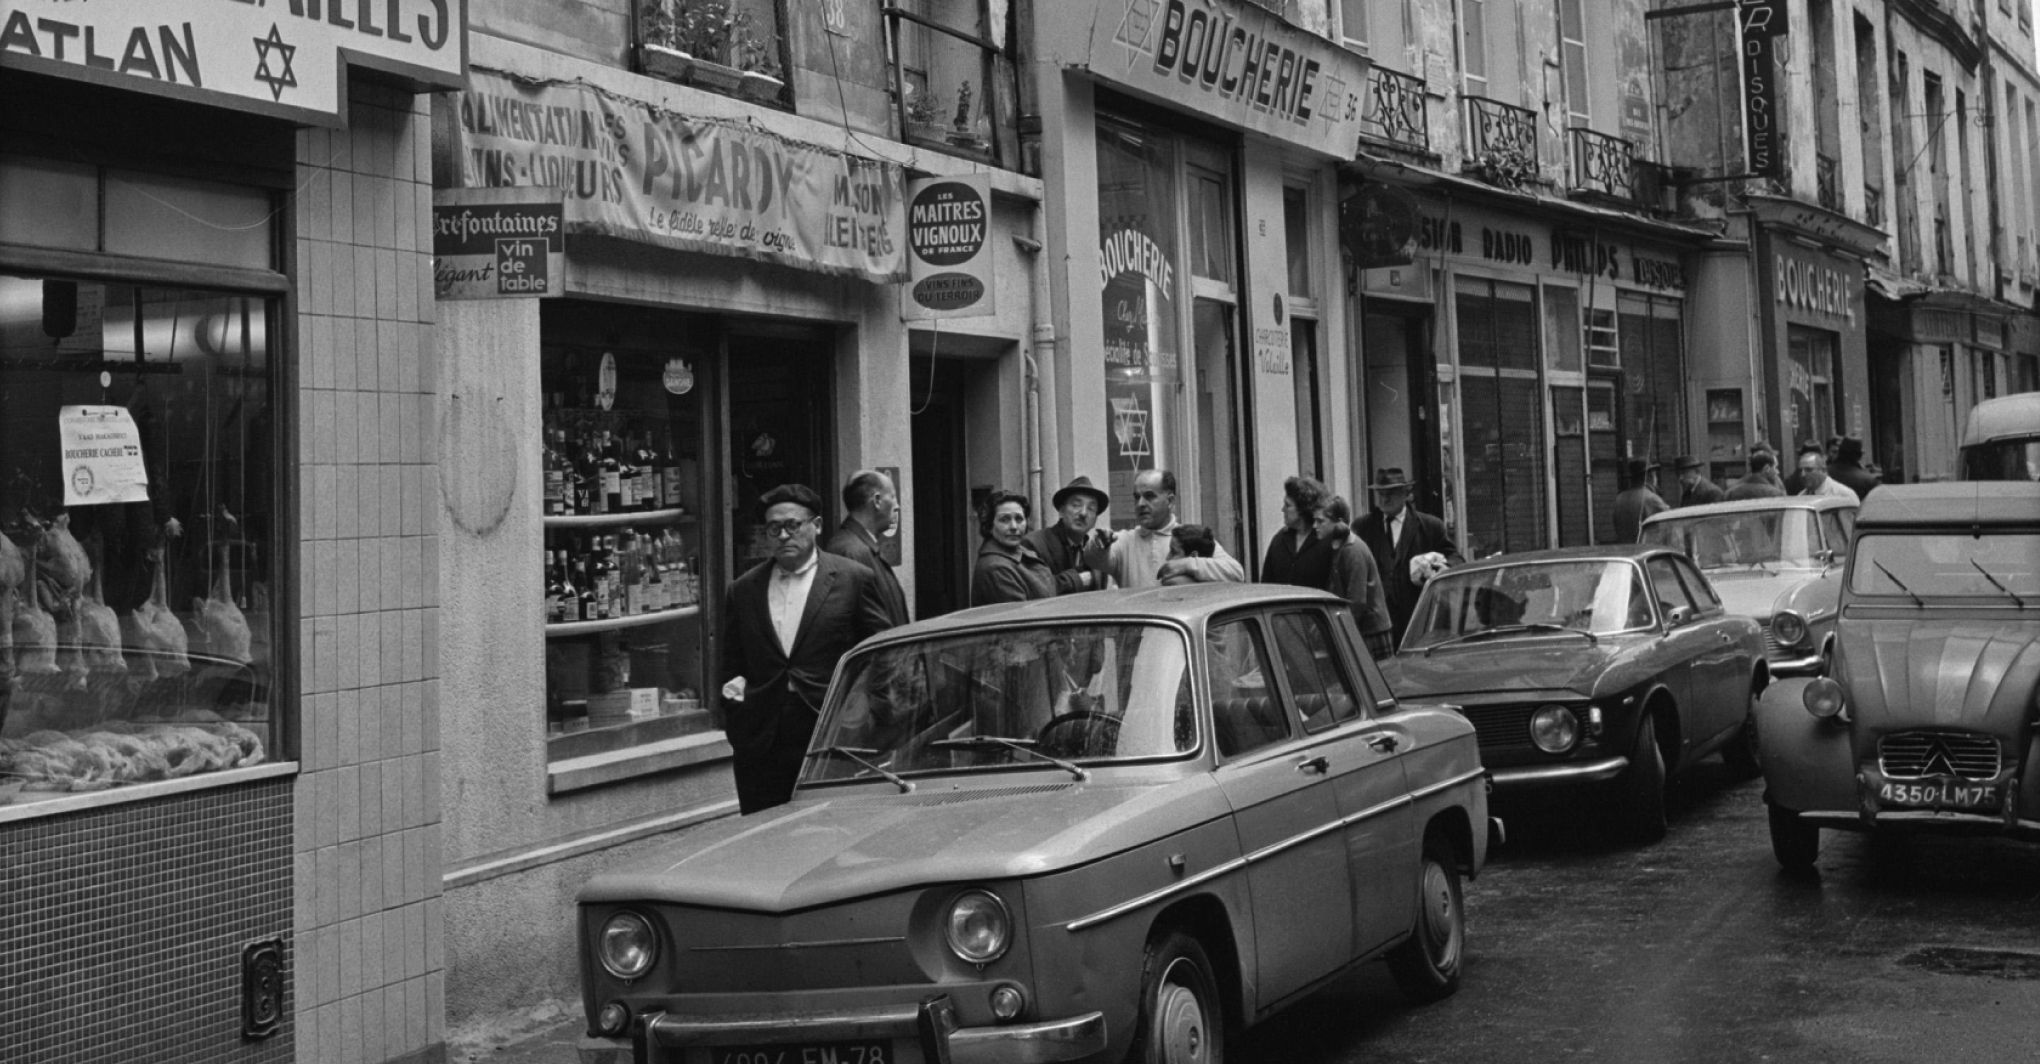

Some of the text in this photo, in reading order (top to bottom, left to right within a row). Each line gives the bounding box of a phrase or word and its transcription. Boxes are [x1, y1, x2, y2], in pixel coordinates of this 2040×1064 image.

[0, 9, 202, 88] ATLAN
[1153, 0, 1321, 125] BOUCHERIE
[1746, 40, 1769, 168] DISQUES
[642, 121, 795, 220] PICARDY
[937, 192, 954, 200] LES
[648, 206, 665, 230] Le
[913, 200, 982, 224] MAITRES
[913, 223, 982, 247] VIGNOUX
[1482, 226, 1533, 266] RADIO
[500, 241, 534, 257] vin
[921, 245, 975, 256] DE FRANCE
[500, 257, 526, 274] de
[1099, 228, 1173, 301] BOUCHERIE
[500, 274, 546, 291] table
[925, 277, 974, 290] VINS FINS
[1776, 253, 1853, 318] BOUCHERIE
[917, 289, 980, 303] DU TERROIR
